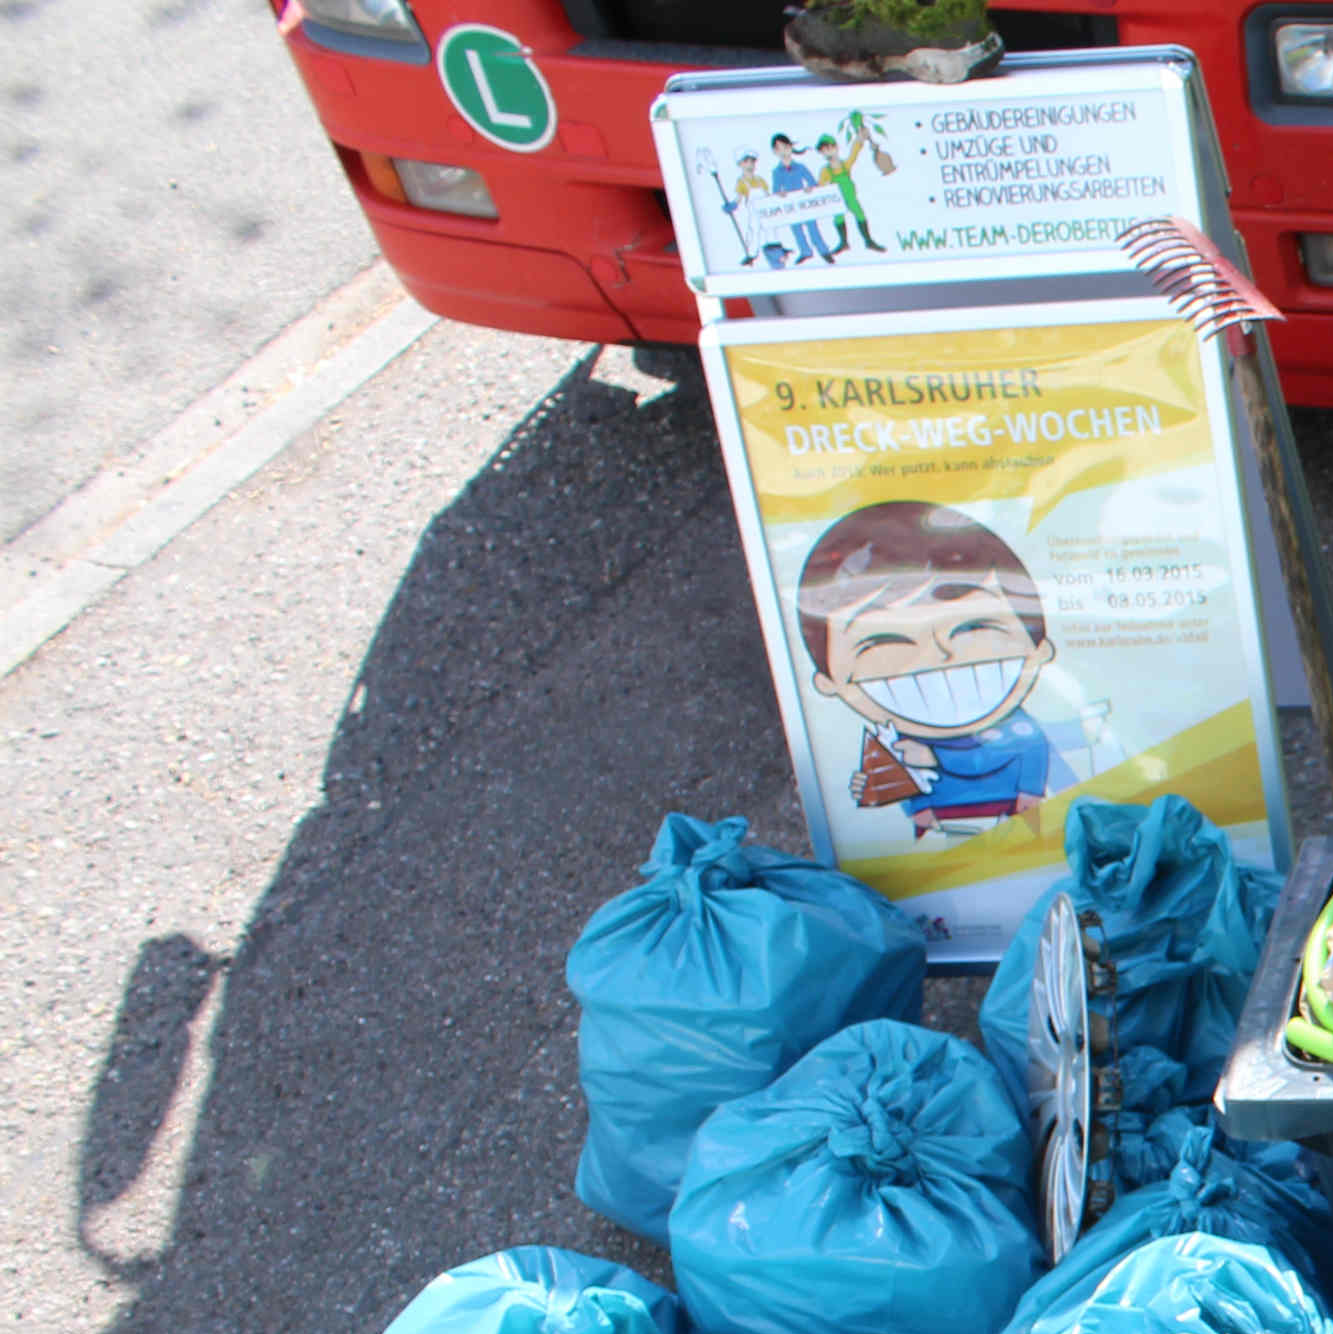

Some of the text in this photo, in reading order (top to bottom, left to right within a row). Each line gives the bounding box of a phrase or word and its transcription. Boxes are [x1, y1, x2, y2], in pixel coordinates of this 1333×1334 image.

[465, 50, 532, 128] L
[931, 102, 1137, 134] GEBÄUDEREINIGUNGEN
[935, 134, 1058, 160] UMZÜGE UND
[940, 154, 1112, 184] ENTRÜMPELUNGEN
[944, 175, 1166, 208] RENOVIERUNGSARBEITEN
[775, 368, 1043, 412] 9. KARLSRUHER
[784, 405, 1163, 456] DRECK-WEG-WOCHEN
[1053, 573, 1093, 585] vom
